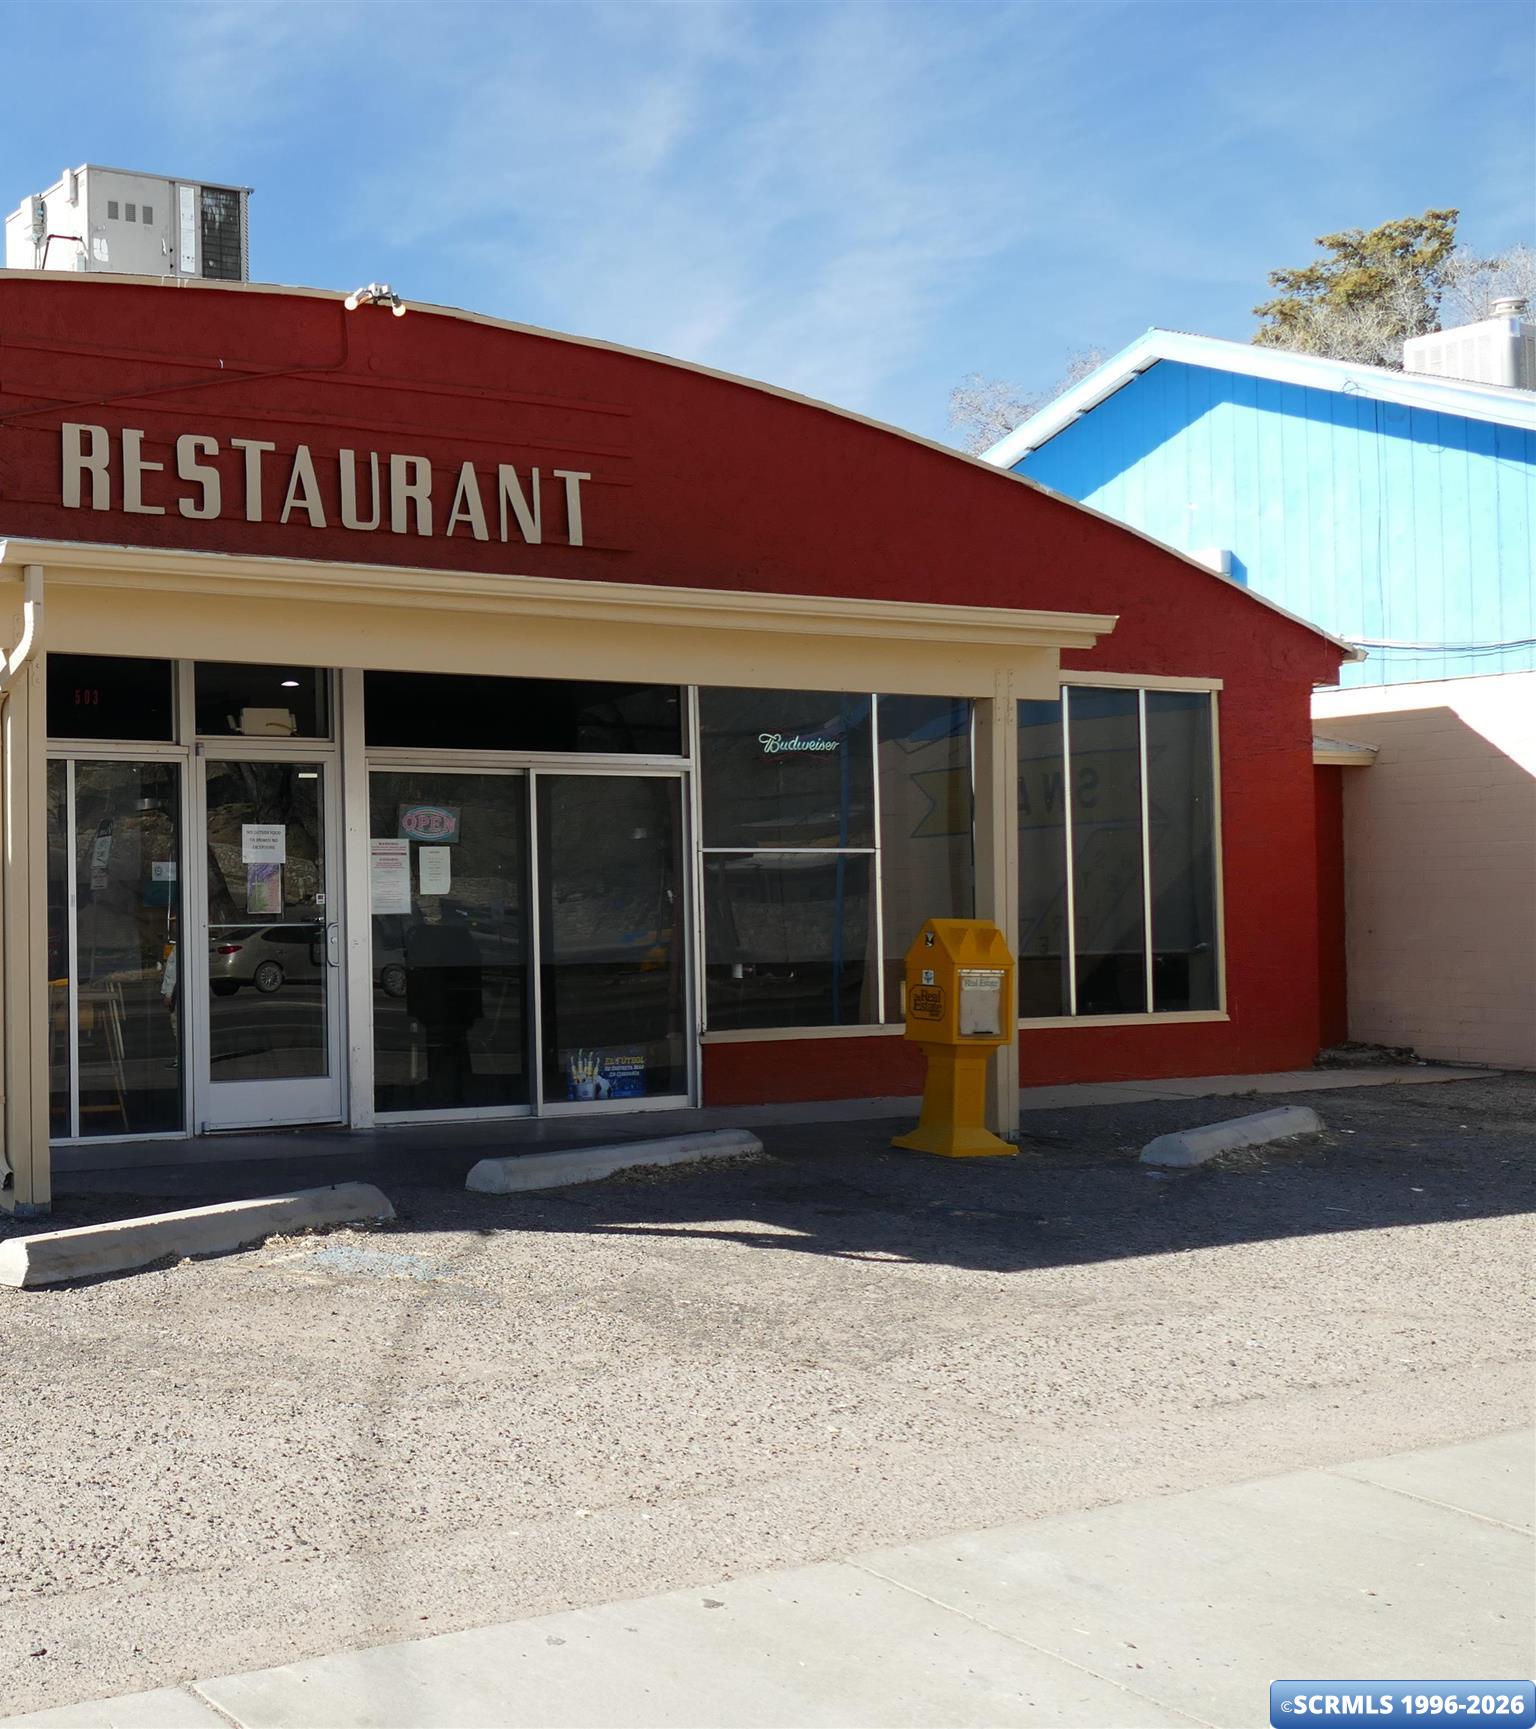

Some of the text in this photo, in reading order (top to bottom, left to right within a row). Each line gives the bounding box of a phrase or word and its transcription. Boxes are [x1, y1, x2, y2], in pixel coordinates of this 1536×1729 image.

[62, 422, 591, 546] RESTAURANT
[73, 688, 99, 705] 503
[758, 733, 840, 753] Budweiser
[402, 813, 456, 833] OPEN
[913, 998, 942, 1011] Estate
[920, 989, 941, 1003] Real
